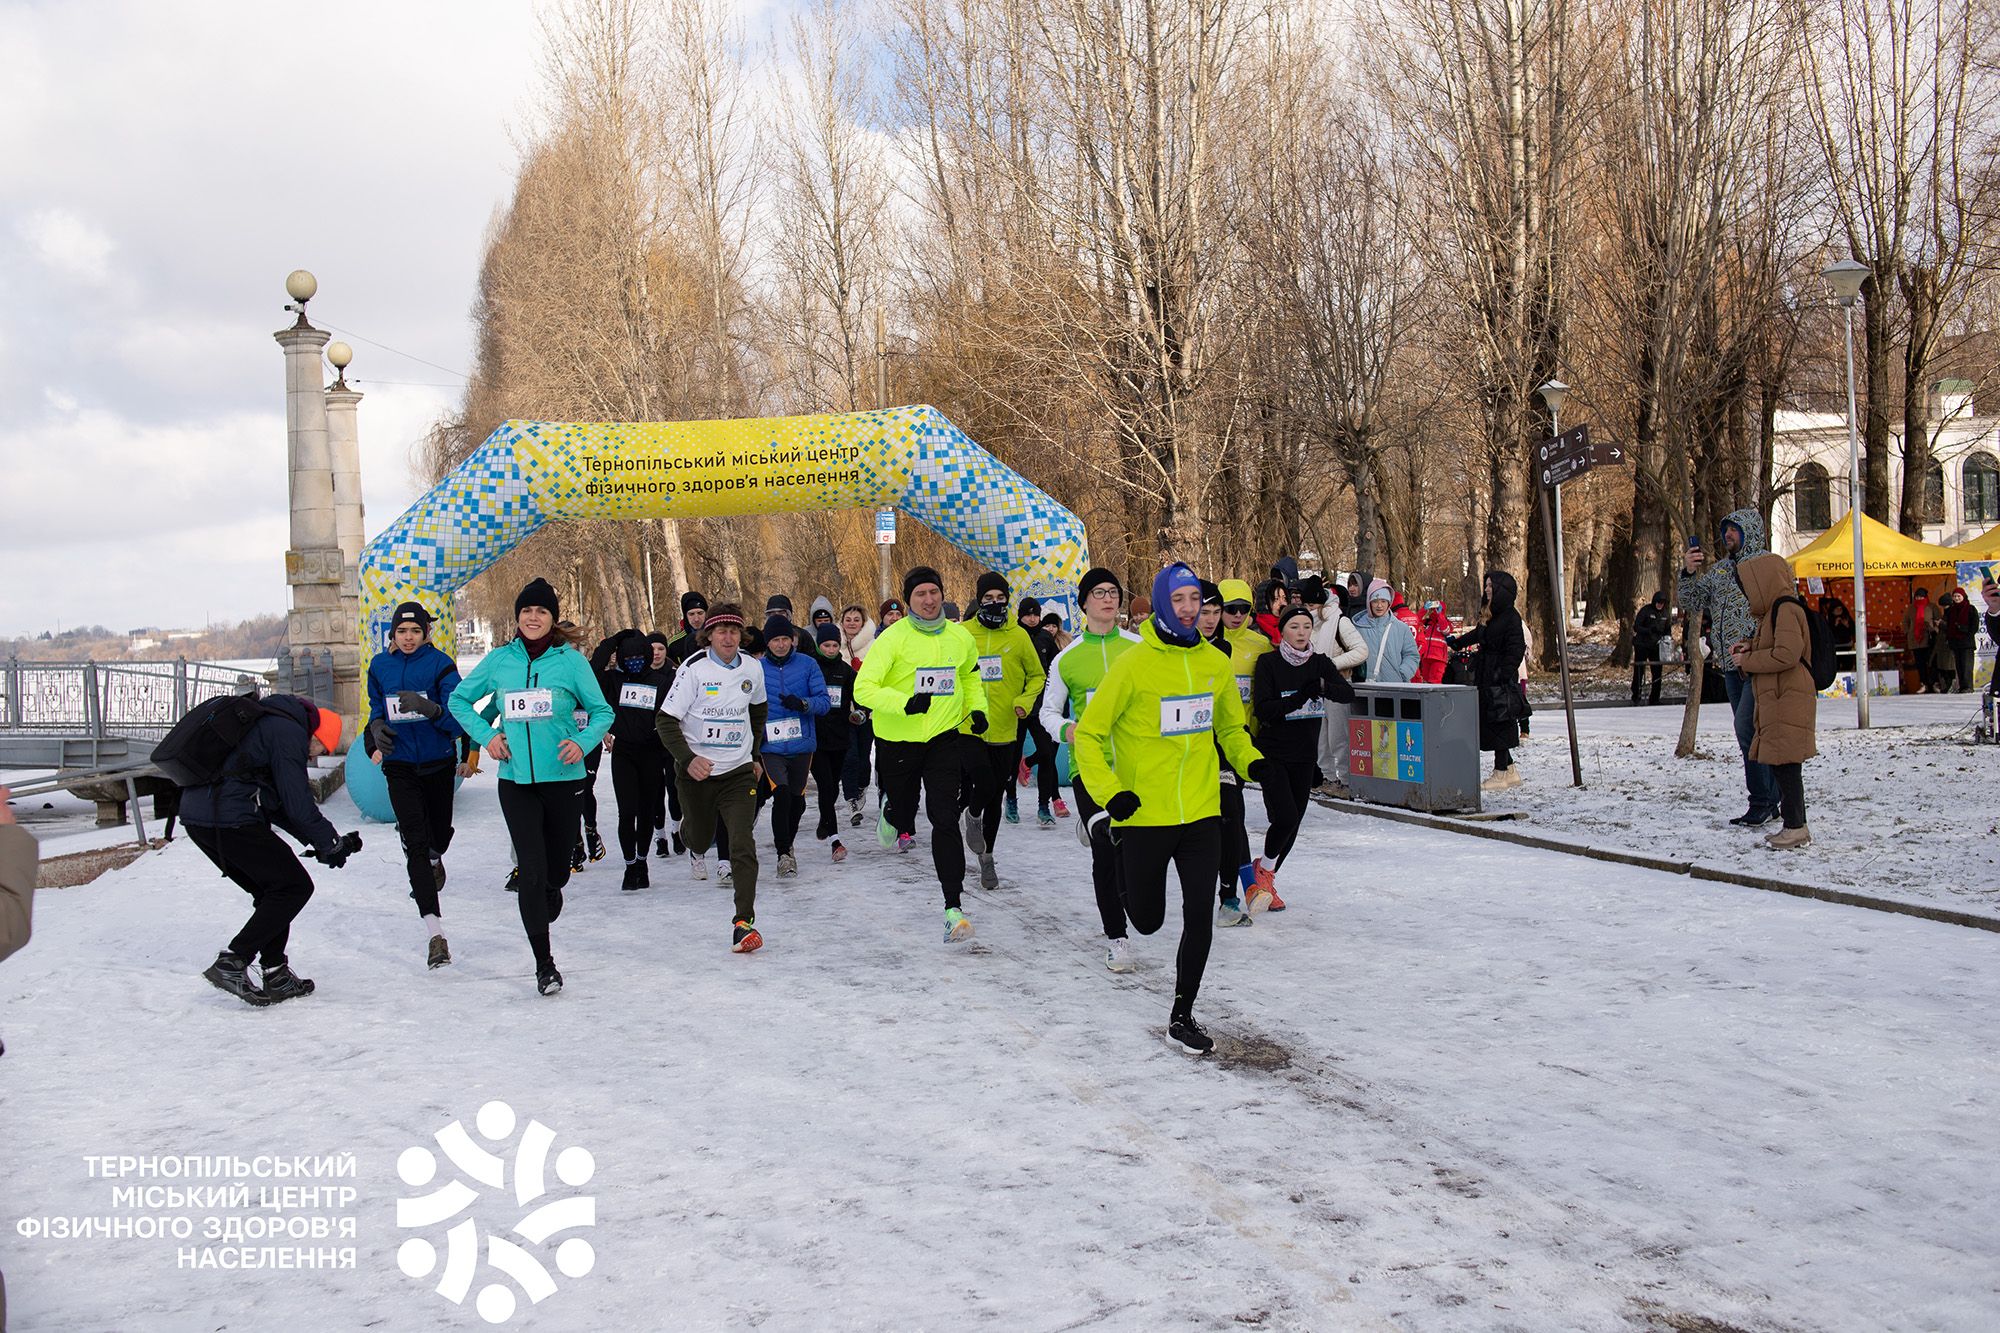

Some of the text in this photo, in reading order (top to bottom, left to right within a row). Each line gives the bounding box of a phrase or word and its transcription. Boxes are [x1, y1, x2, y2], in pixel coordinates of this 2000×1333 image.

[583, 446, 860, 474] Тернопільський міський центр
[585, 481, 676, 497] фізичного
[764, 470, 860, 487] населення
[1901, 560, 1937, 569] МІСЬКА
[921, 676, 935, 687] 19
[625, 691, 637, 700] 12
[511, 699, 526, 711] 18
[702, 707, 724, 716] ARENA
[1176, 708, 1180, 722] 1
[707, 728, 720, 739] 31
[773, 727, 780, 735] 6
[1399, 753, 1421, 763] ПЛАСТИК
